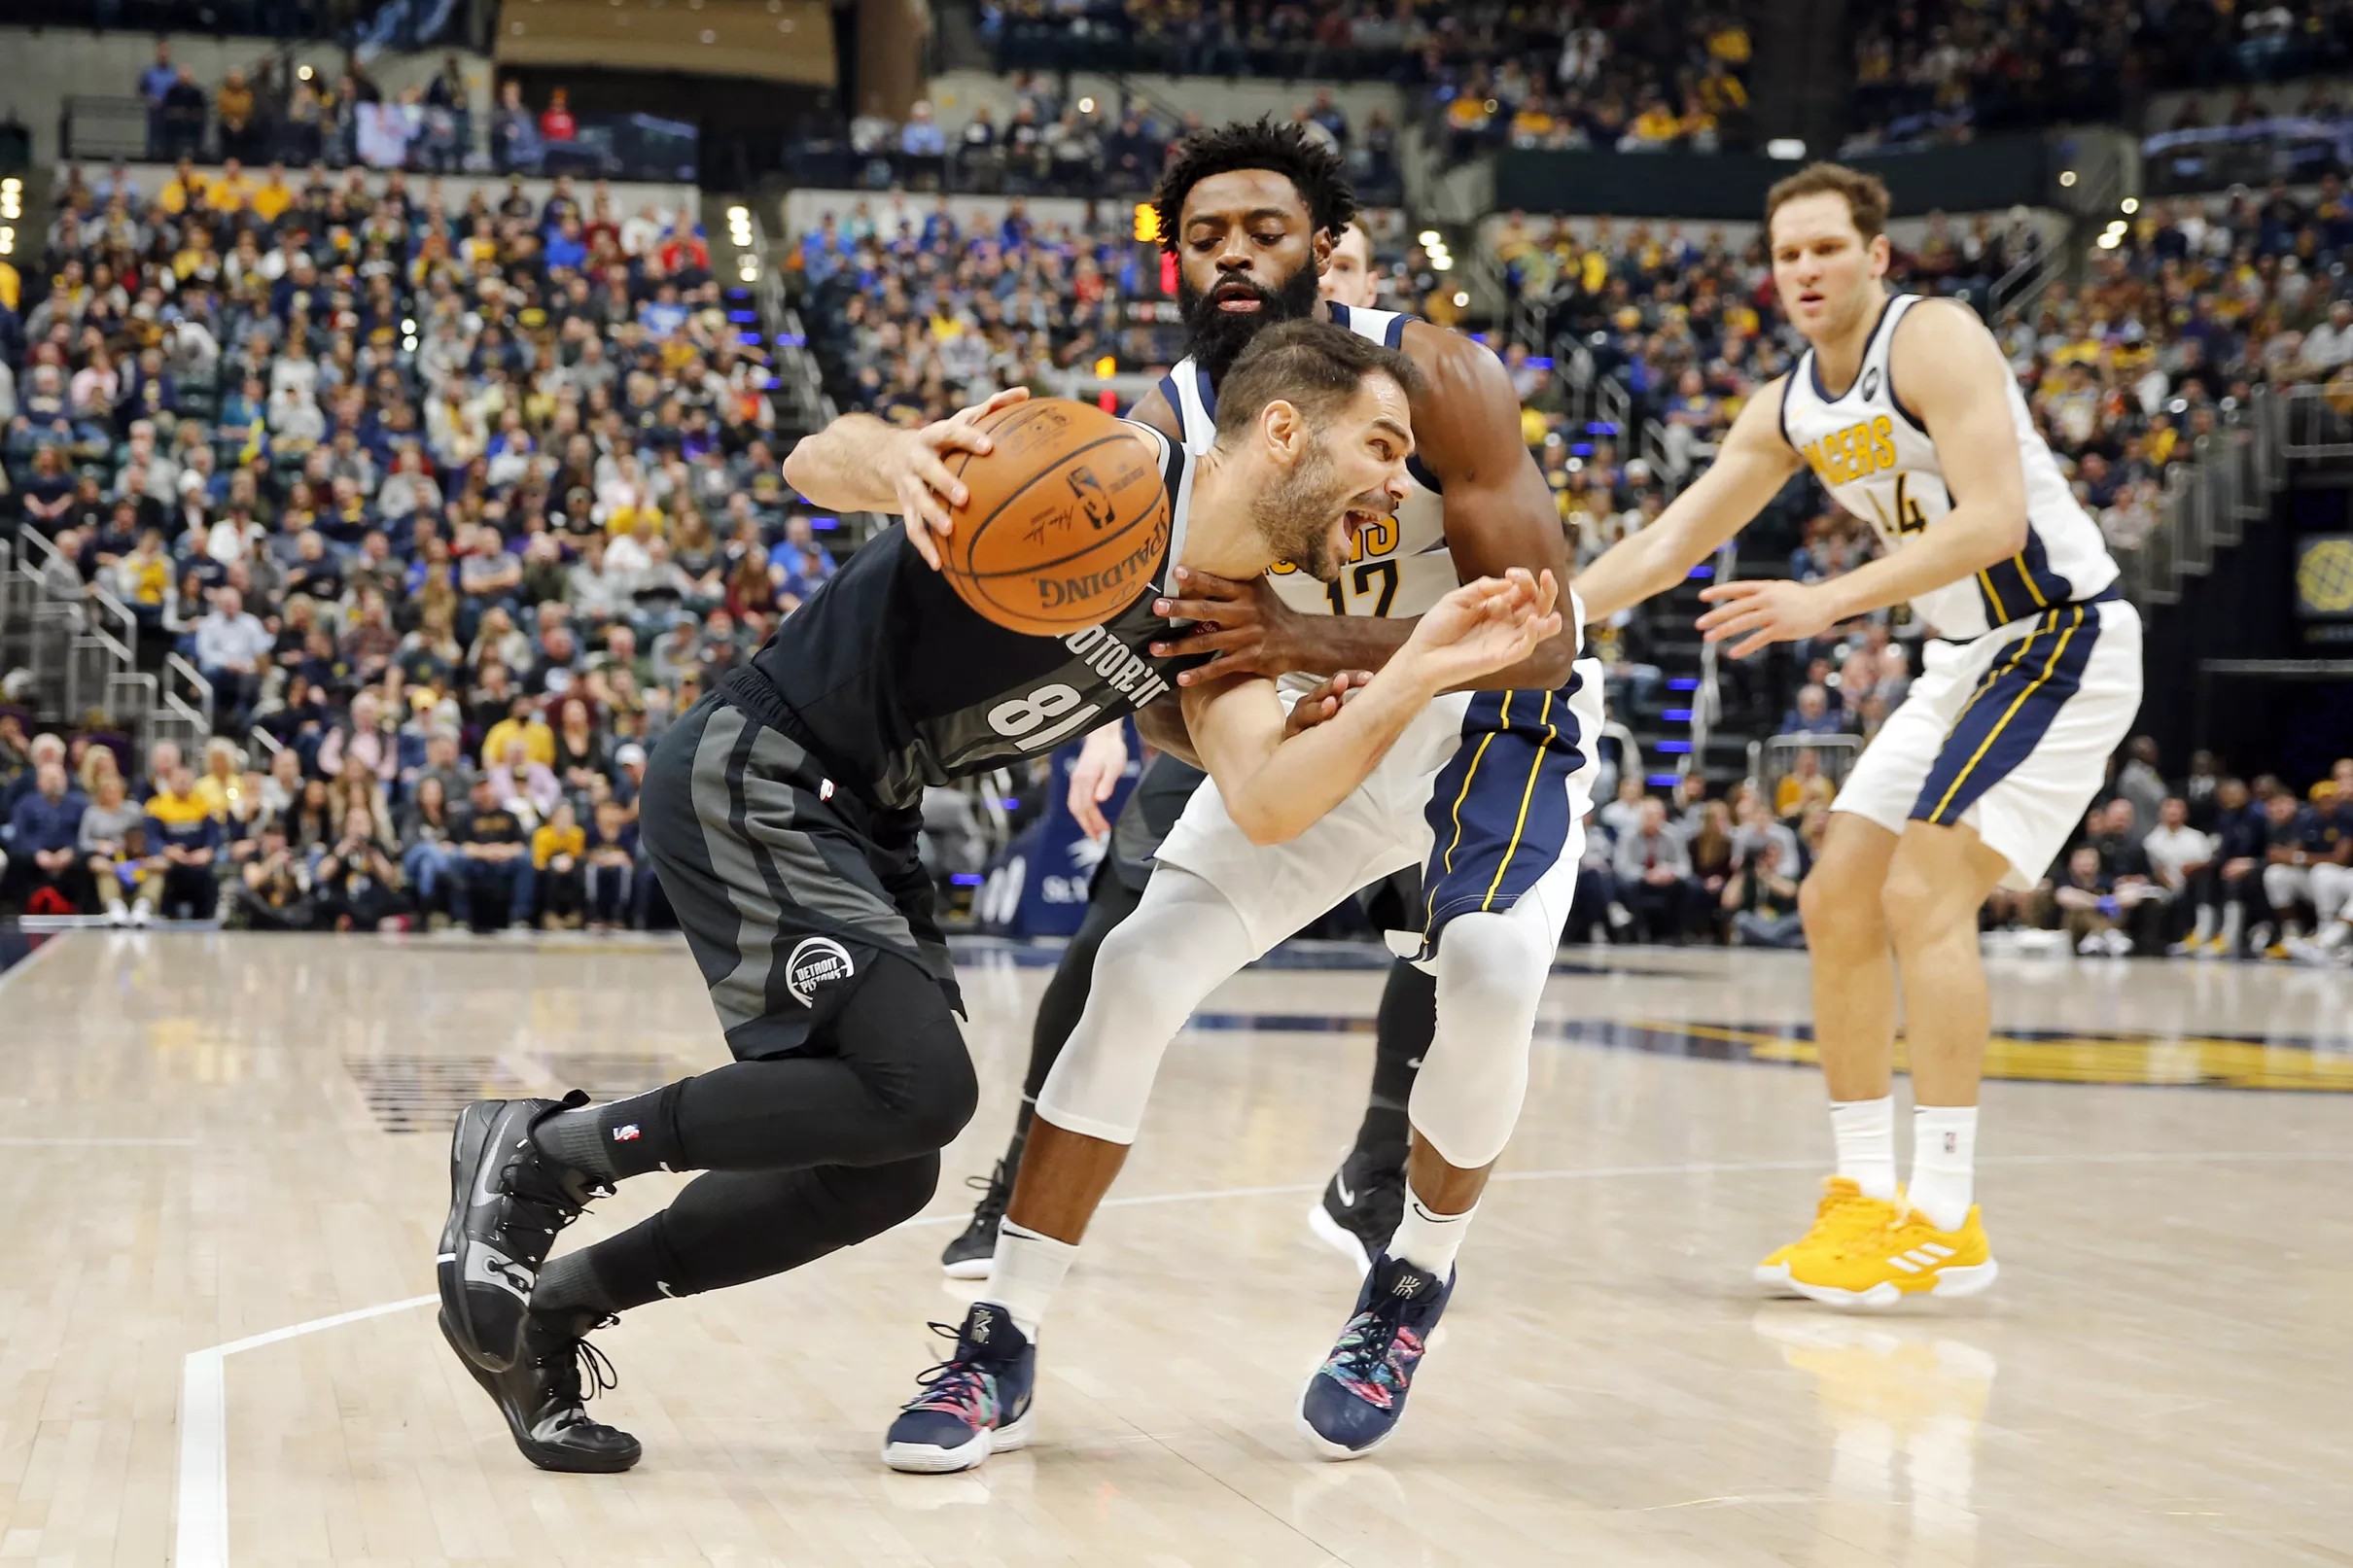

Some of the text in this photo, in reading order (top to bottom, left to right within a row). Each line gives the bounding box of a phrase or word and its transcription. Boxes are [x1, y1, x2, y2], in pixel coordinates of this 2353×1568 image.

[1037, 505, 1170, 610] SPALDING
[1055, 623, 1145, 690] OTOR
[795, 957, 838, 982] DETROIT
